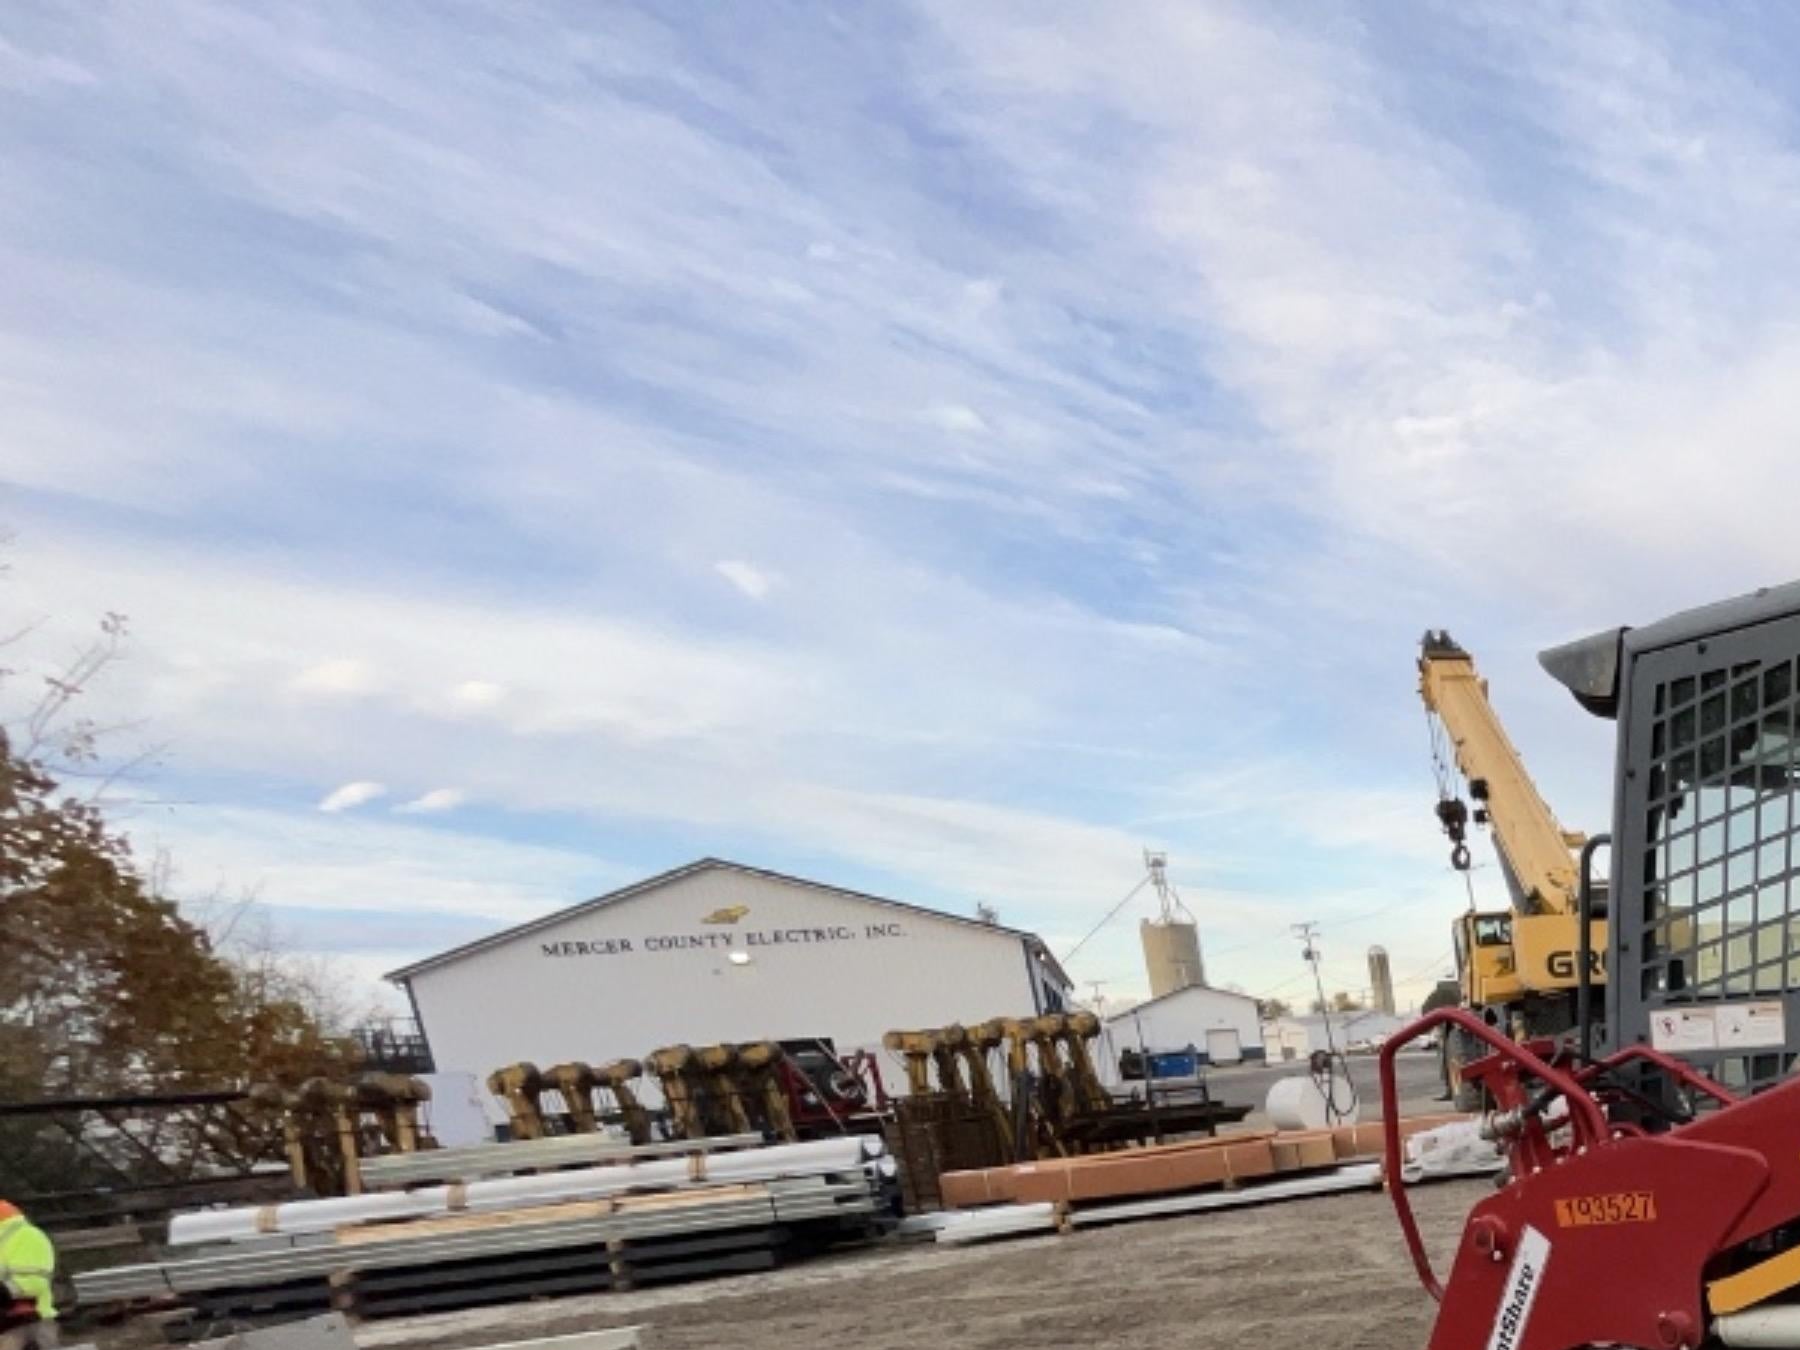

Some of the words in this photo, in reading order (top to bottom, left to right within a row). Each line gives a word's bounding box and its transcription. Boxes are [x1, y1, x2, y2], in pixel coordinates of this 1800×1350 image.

[542, 939, 633, 957] MERCER
[644, 932, 733, 951] COUNTY
[864, 923, 908, 938] INC.
[1565, 1192, 1651, 1225] 193527
